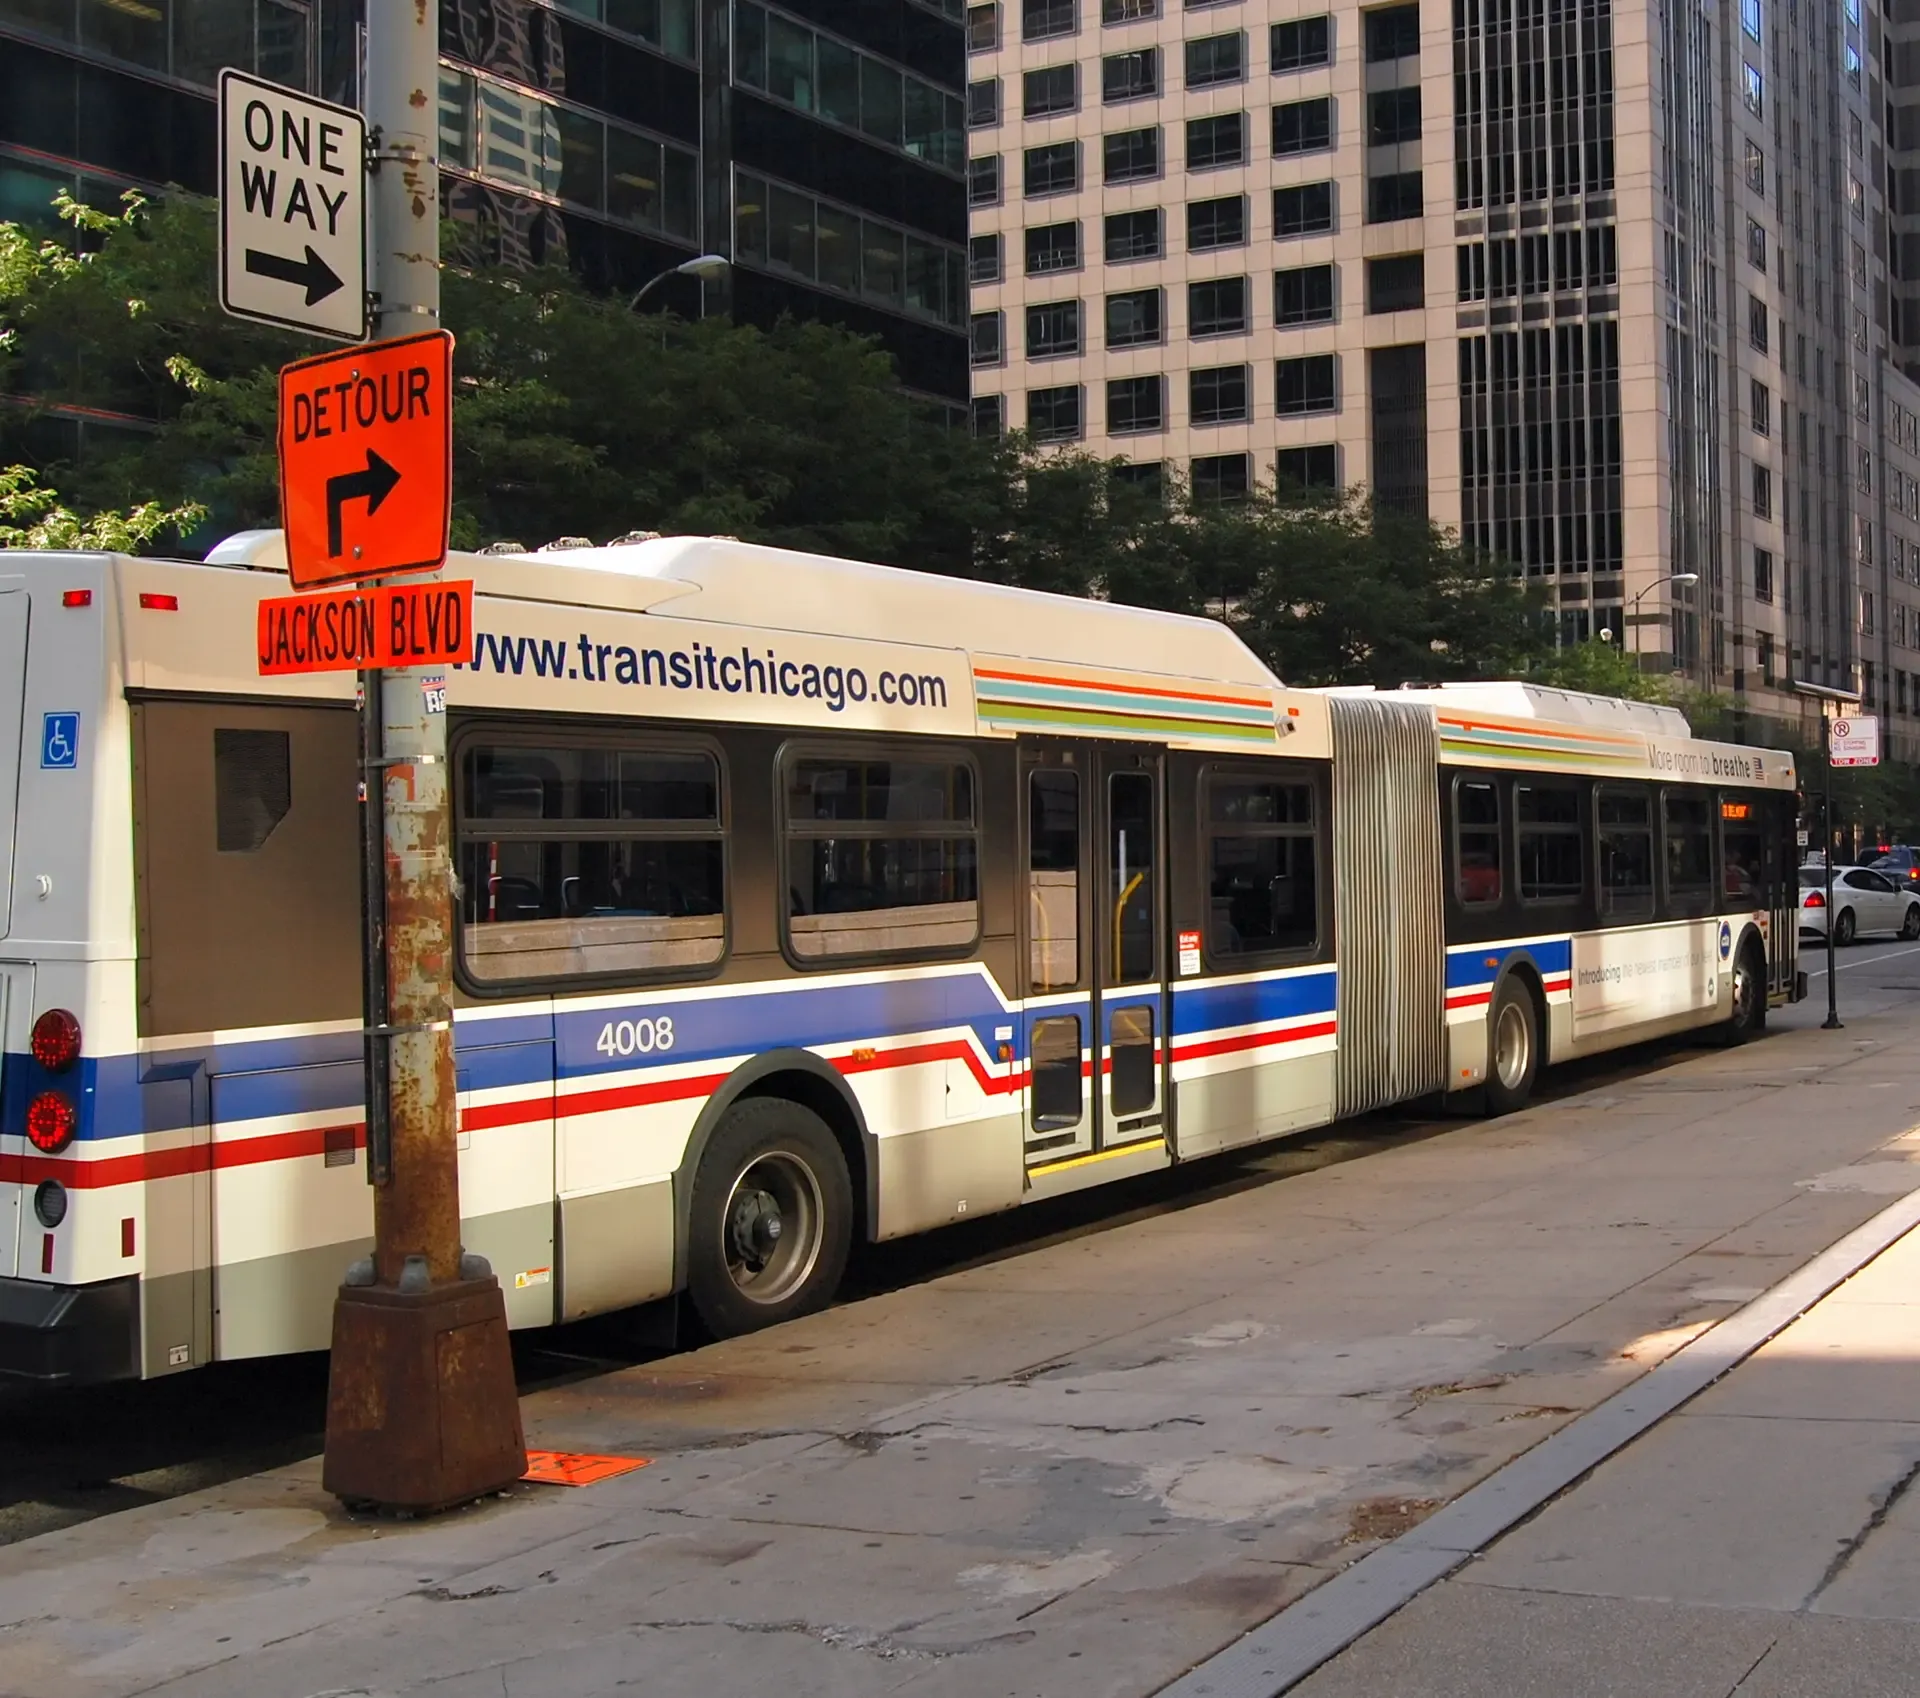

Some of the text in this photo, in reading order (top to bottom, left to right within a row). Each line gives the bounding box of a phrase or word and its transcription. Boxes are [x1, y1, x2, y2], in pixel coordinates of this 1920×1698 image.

[245, 100, 345, 176] ONE
[241, 161, 347, 236] WAY
[294, 367, 430, 443] DETOUR
[260, 591, 462, 666] JACKSON BLVD
[1648, 743, 1751, 778] More room to breathe
[1854, 757, 1872, 765] ZONE
[1578, 964, 1621, 985] Introducing
[596, 1016, 674, 1056] 4008
